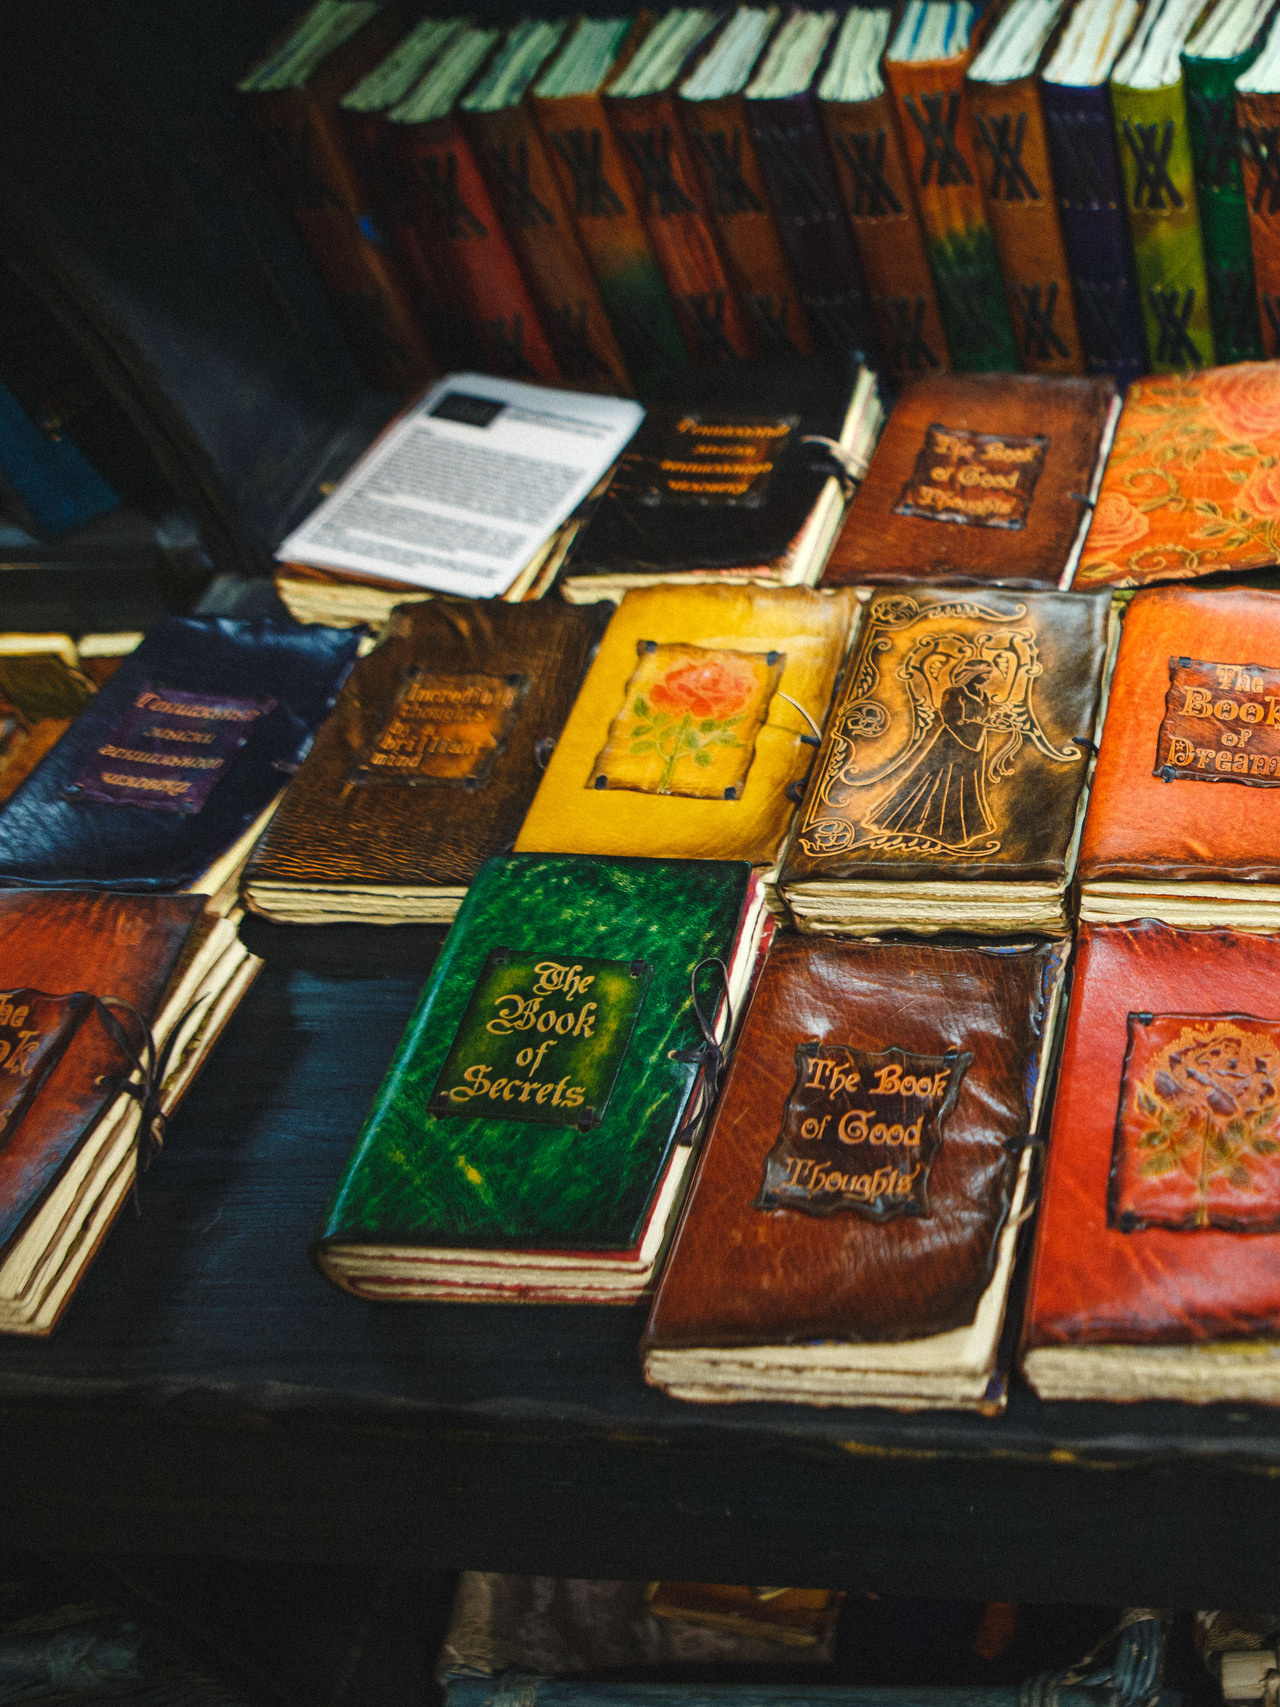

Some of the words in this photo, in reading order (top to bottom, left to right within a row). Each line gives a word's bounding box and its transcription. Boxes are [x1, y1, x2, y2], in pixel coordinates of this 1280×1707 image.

[934, 432, 976, 464] The
[980, 442, 1039, 463] Book
[957, 464, 1020, 489] Good
[1216, 664, 1264, 694] The
[1221, 727, 1252, 748] of
[370, 751, 424, 768] mind
[533, 961, 595, 1002] The
[486, 994, 598, 1038] Book
[516, 1030, 558, 1077] of
[450, 1064, 586, 1108] Secrets
[804, 1057, 861, 1100] The
[869, 1063, 951, 1098] Book
[801, 1115, 832, 1140] of
[838, 1109, 925, 1147] Good
[781, 1156, 921, 1203] Thoughts
